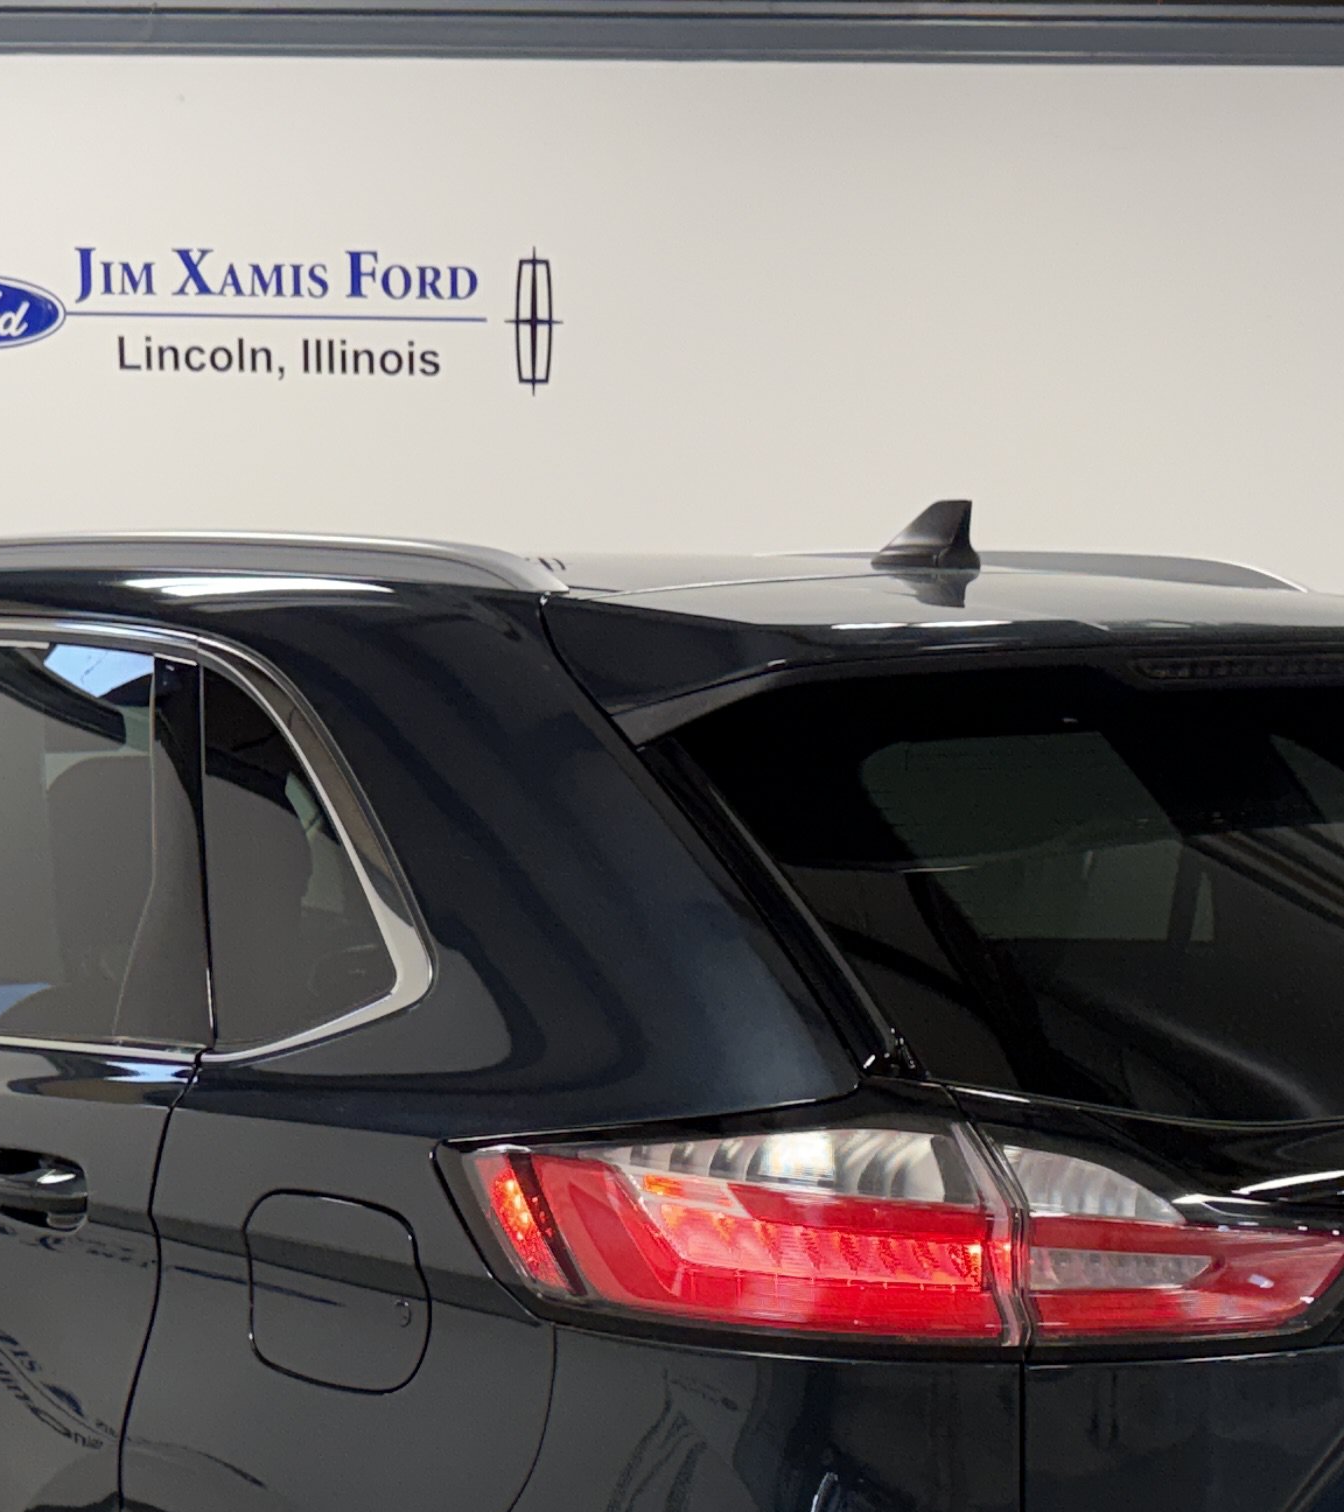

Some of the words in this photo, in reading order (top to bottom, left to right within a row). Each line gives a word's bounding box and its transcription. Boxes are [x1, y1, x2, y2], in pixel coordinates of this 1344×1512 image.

[74, 247, 155, 303] JIM
[172, 248, 329, 300] XAMIS
[345, 251, 478, 301] FORD
[117, 335, 285, 379] Lincoln,
[301, 338, 440, 377] Illinois
